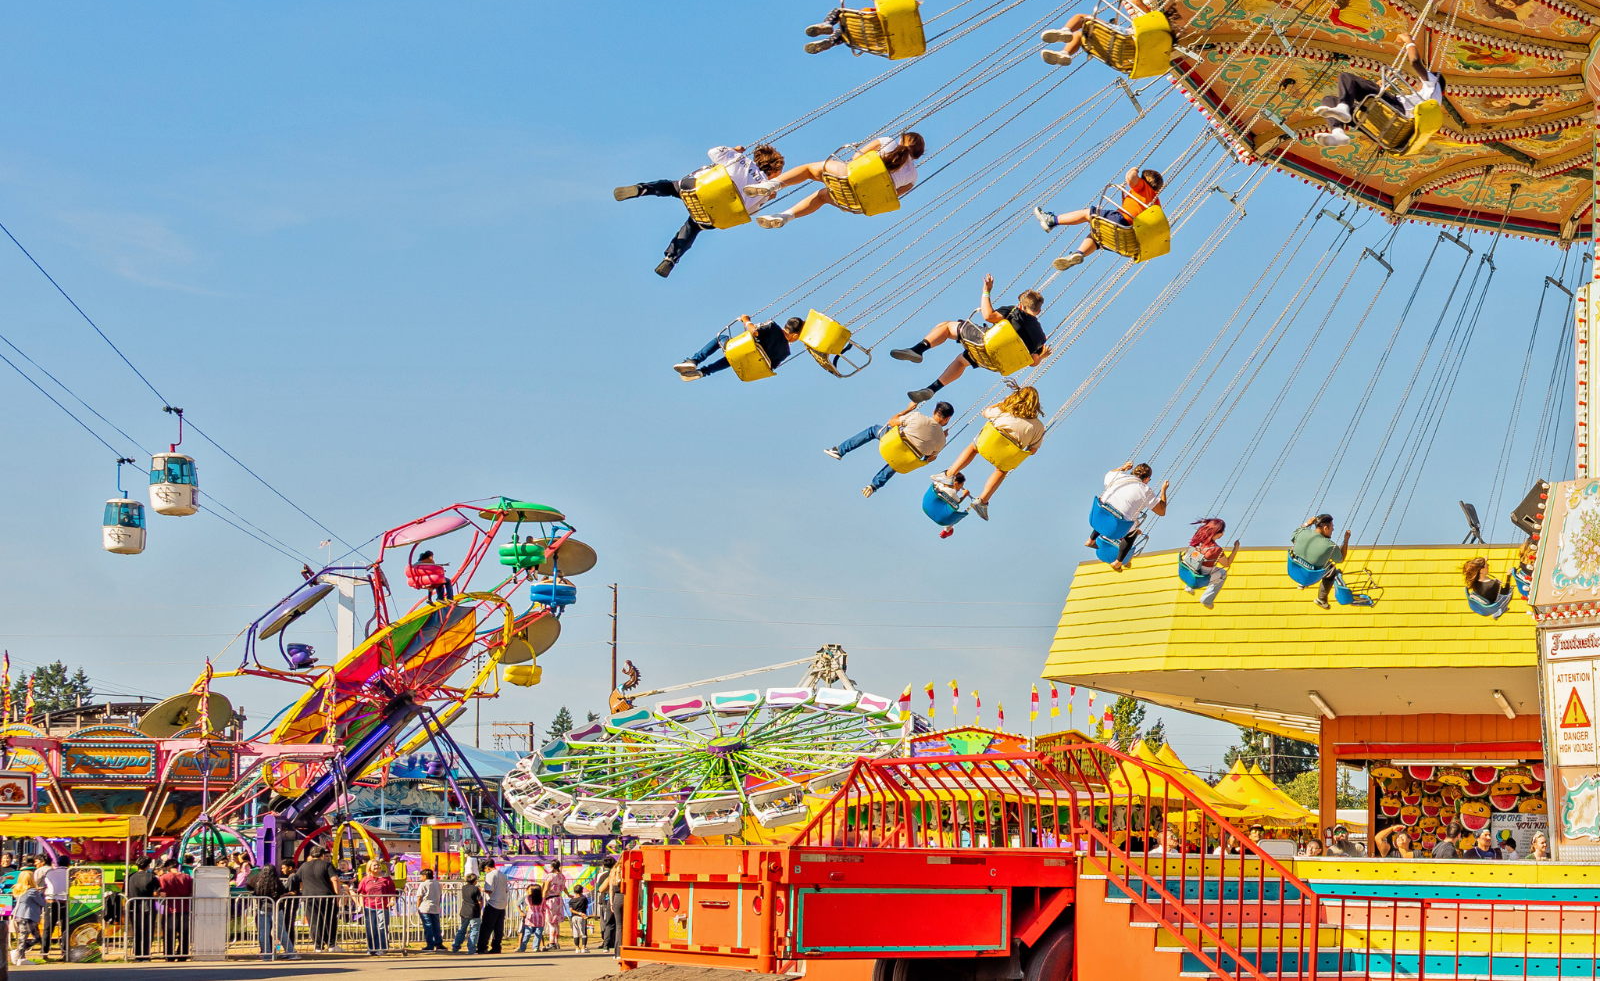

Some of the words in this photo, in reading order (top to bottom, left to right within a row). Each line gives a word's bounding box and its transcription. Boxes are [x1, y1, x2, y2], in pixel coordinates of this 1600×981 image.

[1551, 632, 1600, 656] Funtastic
[1557, 672, 1590, 683] ATTENTION
[1563, 731, 1589, 741] DANGER
[1559, 744, 1571, 753] HIGH
[1574, 743, 1594, 753] VOLTAGE
[7, 754, 42, 768] NADO
[69, 753, 150, 771] TORNADO
[1492, 814, 1506, 822] POP
[1507, 814, 1522, 822] ONE
[737, 865, 742, 873] A
[794, 865, 801, 873] B
[990, 868, 996, 876] C
